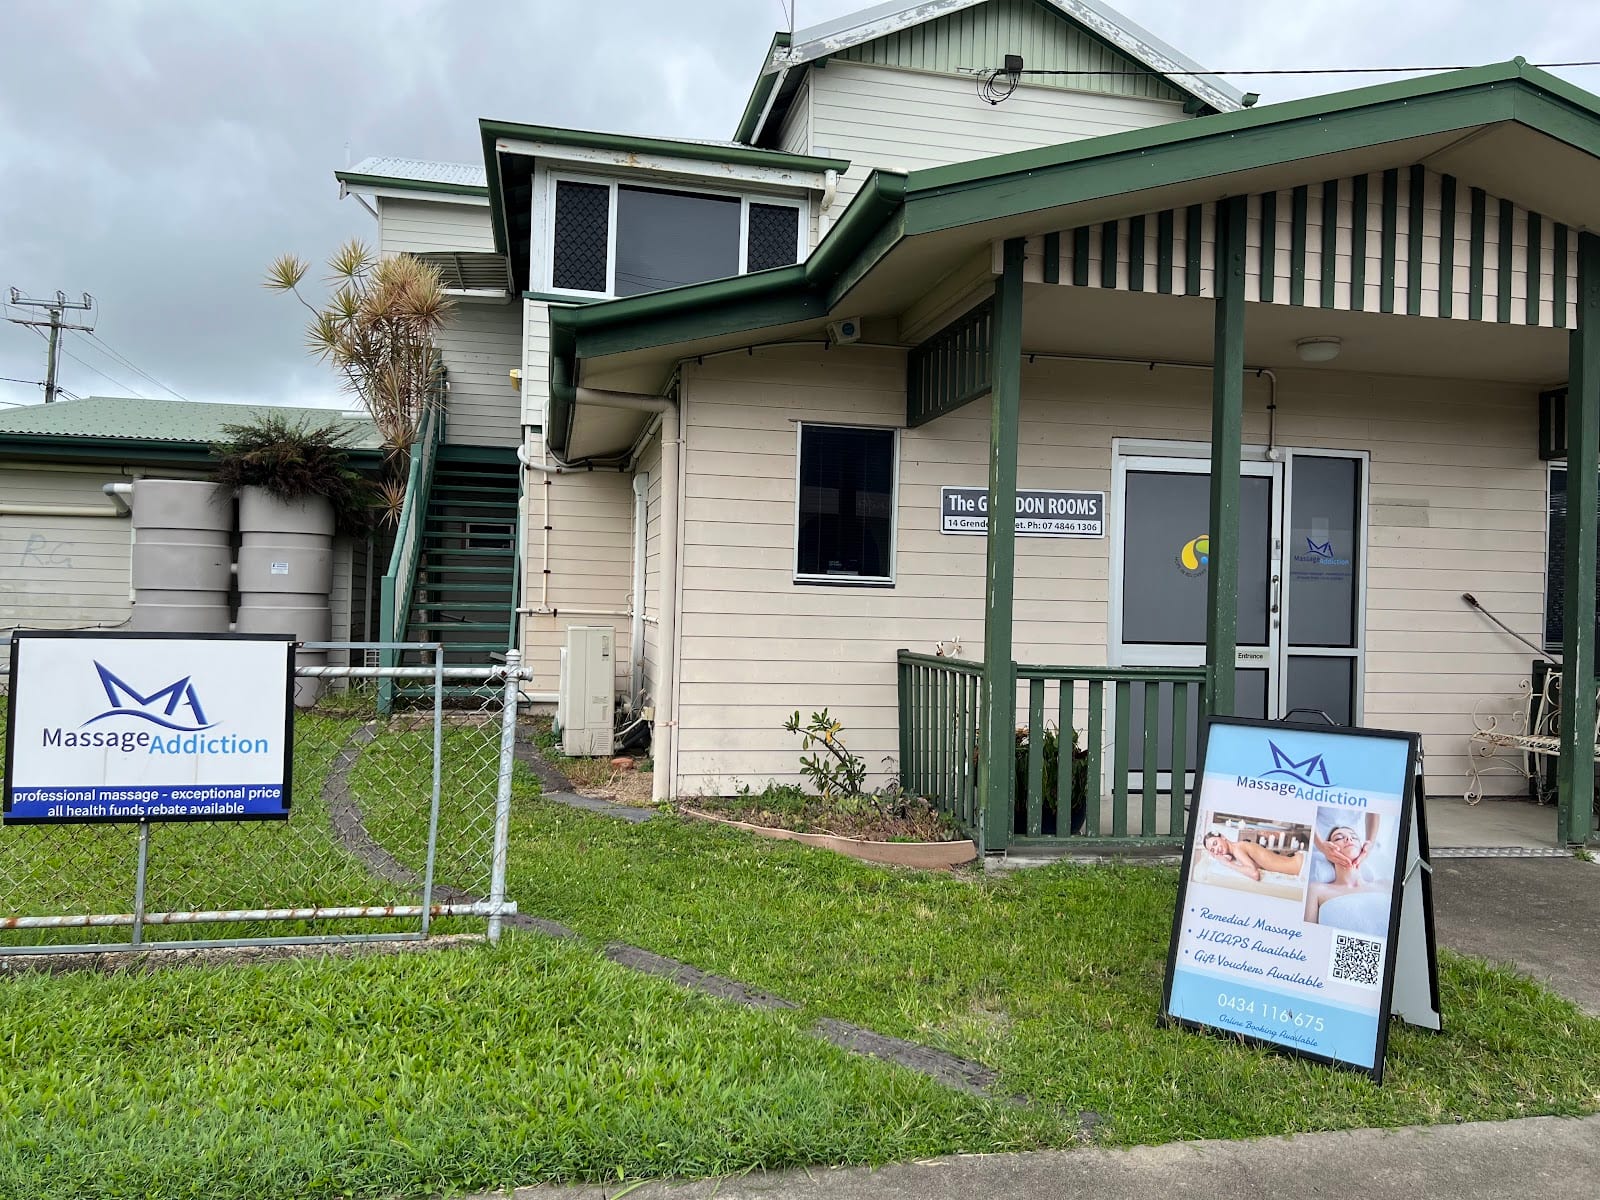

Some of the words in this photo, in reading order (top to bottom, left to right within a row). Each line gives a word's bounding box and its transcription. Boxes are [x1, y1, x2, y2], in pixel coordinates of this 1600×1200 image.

[949, 494, 974, 511] The
[978, 495, 1045, 514] GDON
[1048, 498, 1097, 515] ROOMS
[948, 519, 958, 527] 14
[1028, 521, 1041, 530] Ph:
[1042, 522, 1053, 530] 07
[1054, 523, 1075, 531] 4846
[1077, 523, 1097, 531] 1306
[13, 789, 96, 804] professional
[99, 790, 159, 803] massage
[171, 787, 245, 801] exceptional
[248, 786, 281, 801] price
[48, 804, 63, 816] all
[66, 804, 106, 816] health
[109, 803, 145, 816] funds
[147, 803, 187, 815] rebate
[190, 802, 245, 814] available
[1200, 907, 1250, 927] Remedial
[1252, 917, 1303, 940] Massage
[1196, 928, 1250, 949] HICAPS
[1251, 940, 1307, 962] Available
[1194, 949, 1216, 964] Gift
[1217, 954, 1264, 975] Vouchers
[1266, 966, 1325, 988] Available
[1217, 993, 1255, 1013] 0434
[1262, 1003, 1289, 1023] 116
[1294, 1012, 1324, 1032] 675
[1219, 1014, 1244, 1027] Online
[1245, 1020, 1278, 1037] Booking
[1279, 1029, 1318, 1047] Available
